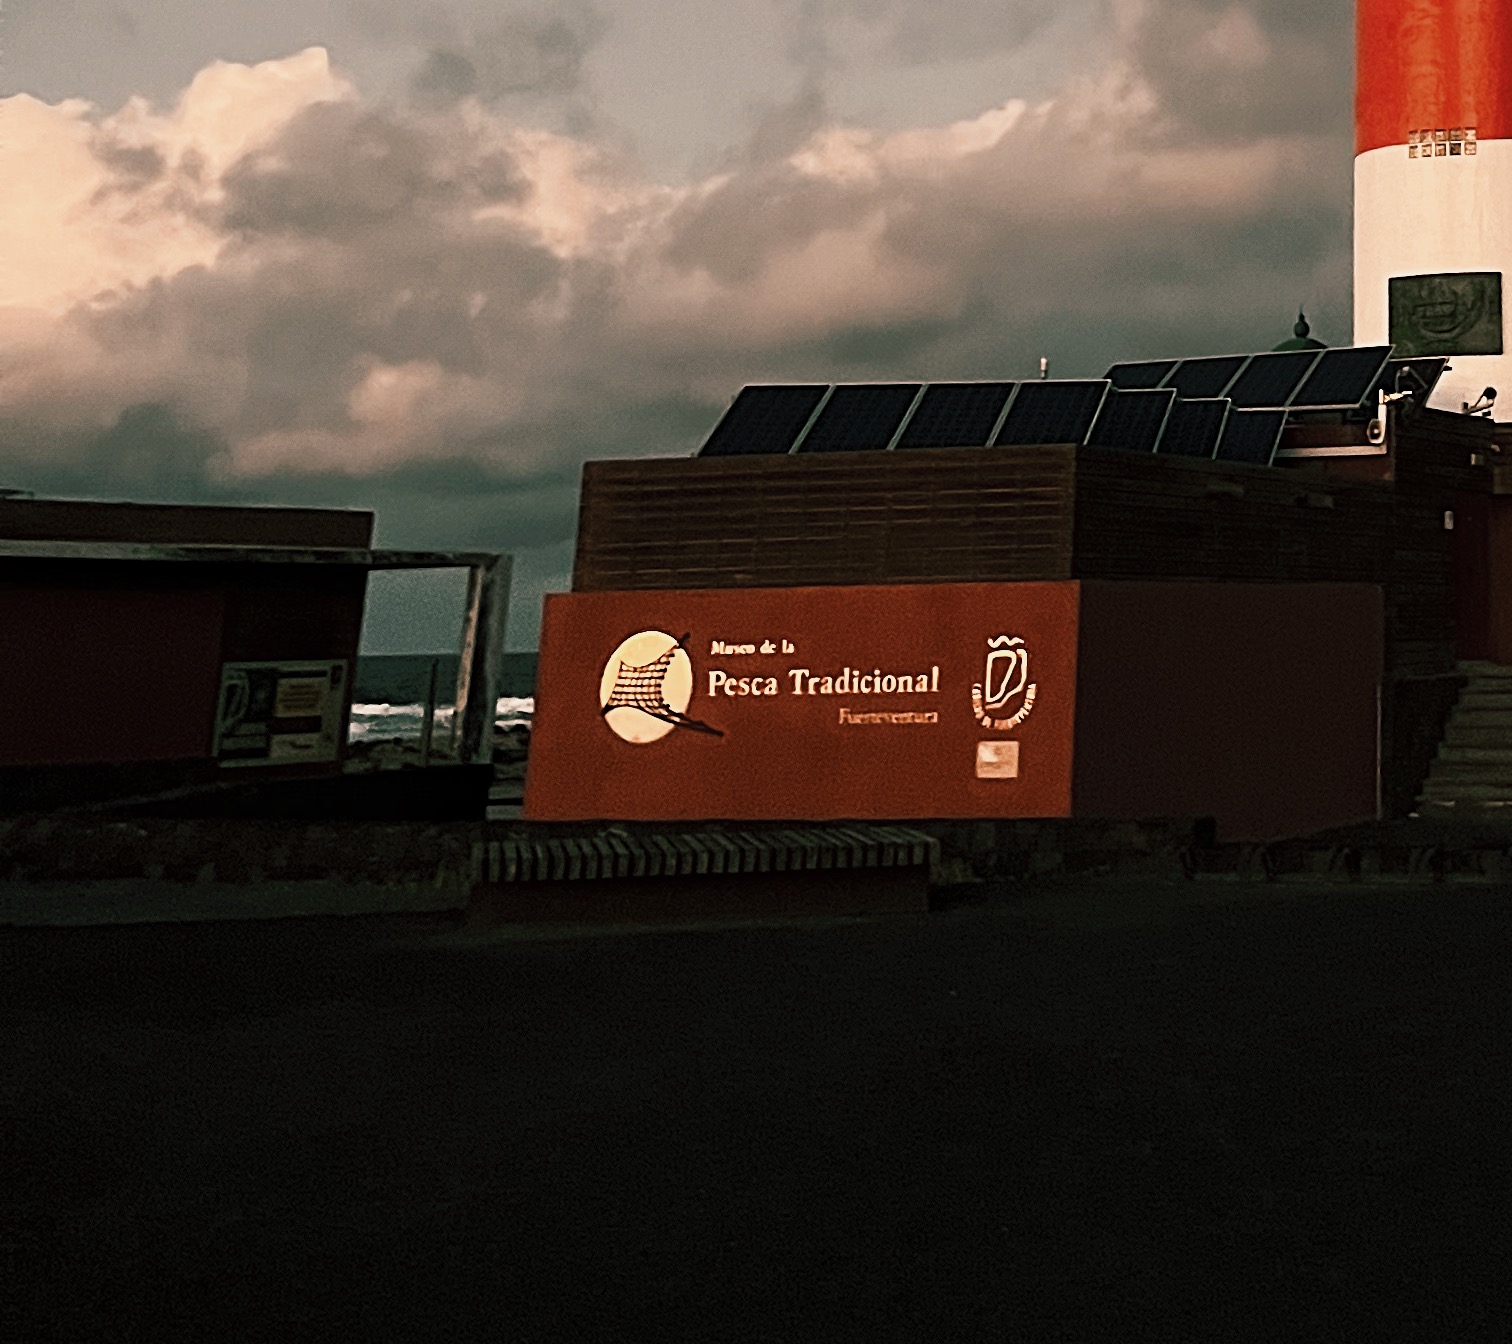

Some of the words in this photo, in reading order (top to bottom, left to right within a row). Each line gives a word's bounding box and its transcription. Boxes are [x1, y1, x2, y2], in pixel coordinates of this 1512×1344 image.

[710, 640, 756, 655] Museo
[760, 640, 777, 654] de
[782, 639, 795, 654] la
[708, 670, 778, 697] Pesca
[788, 666, 940, 695] Tradicional
[838, 708, 939, 724] Fuerteventura
